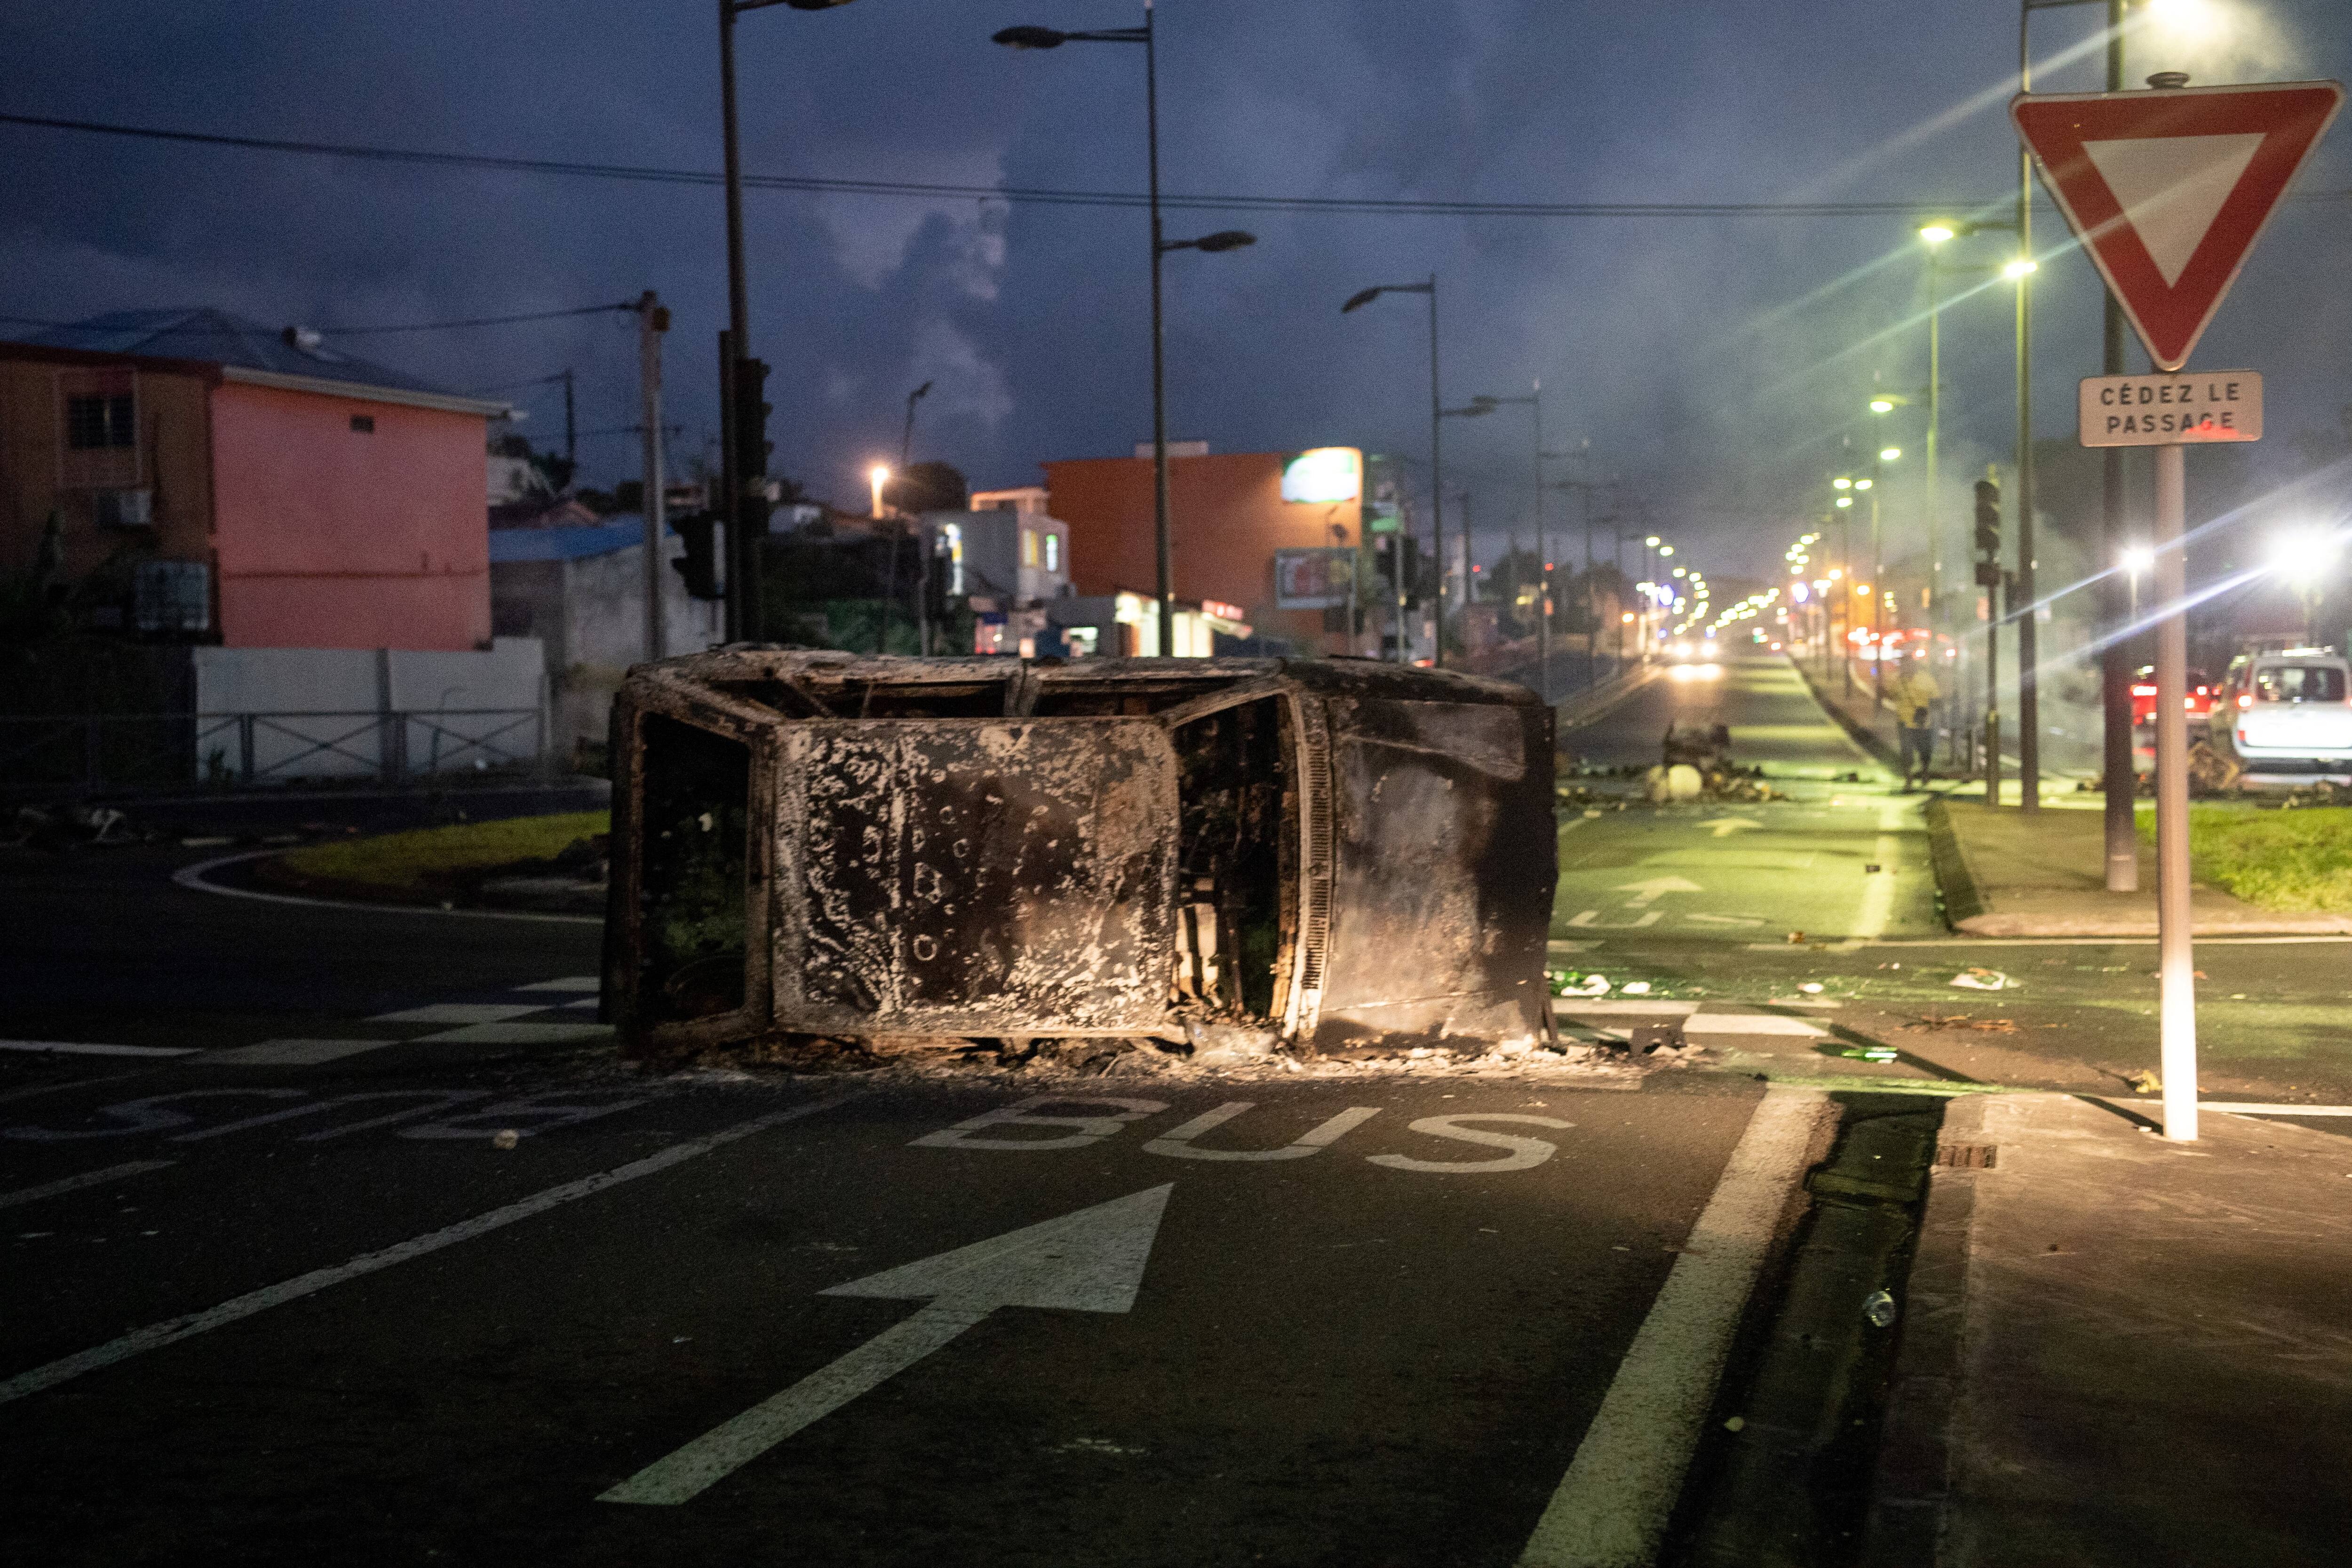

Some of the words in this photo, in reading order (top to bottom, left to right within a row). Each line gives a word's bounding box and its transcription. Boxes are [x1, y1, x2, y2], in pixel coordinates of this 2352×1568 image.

[2100, 383, 2193, 406] CÉDEZ
[2208, 382, 2240, 402] LE
[2106, 411, 2235, 434] PASSAGE
[905, 1094, 1578, 1174] BUS
